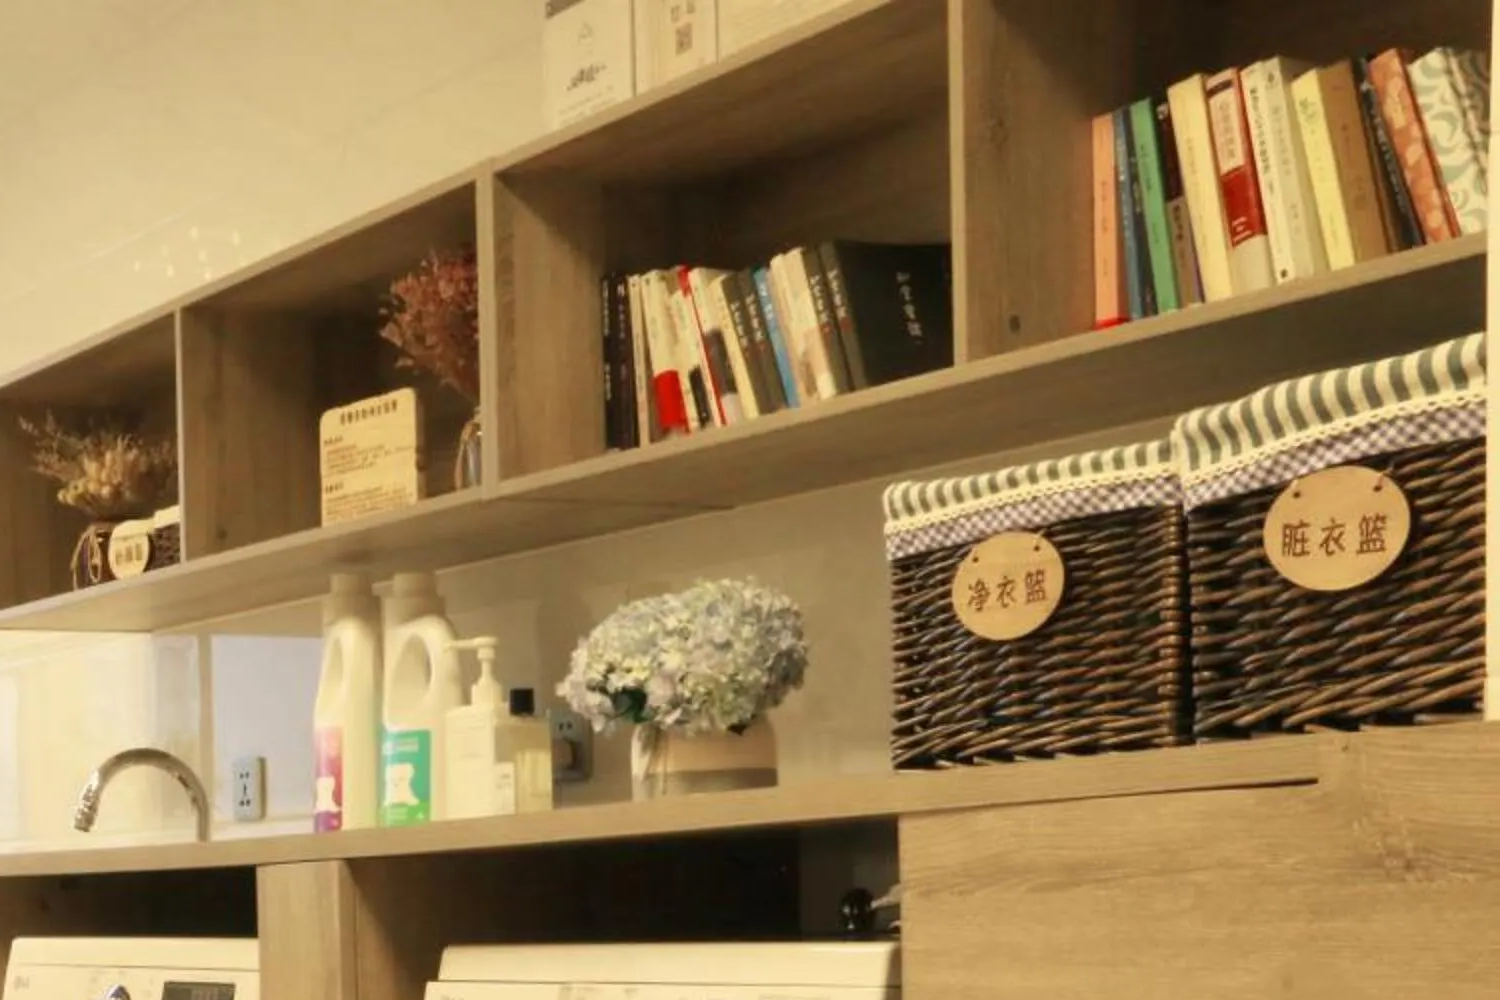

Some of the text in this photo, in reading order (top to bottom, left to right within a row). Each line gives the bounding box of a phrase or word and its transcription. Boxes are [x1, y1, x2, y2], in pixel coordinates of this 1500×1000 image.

[1281, 513, 1387, 557] 脏衣篮
[967, 568, 1047, 612] 净衣篮
